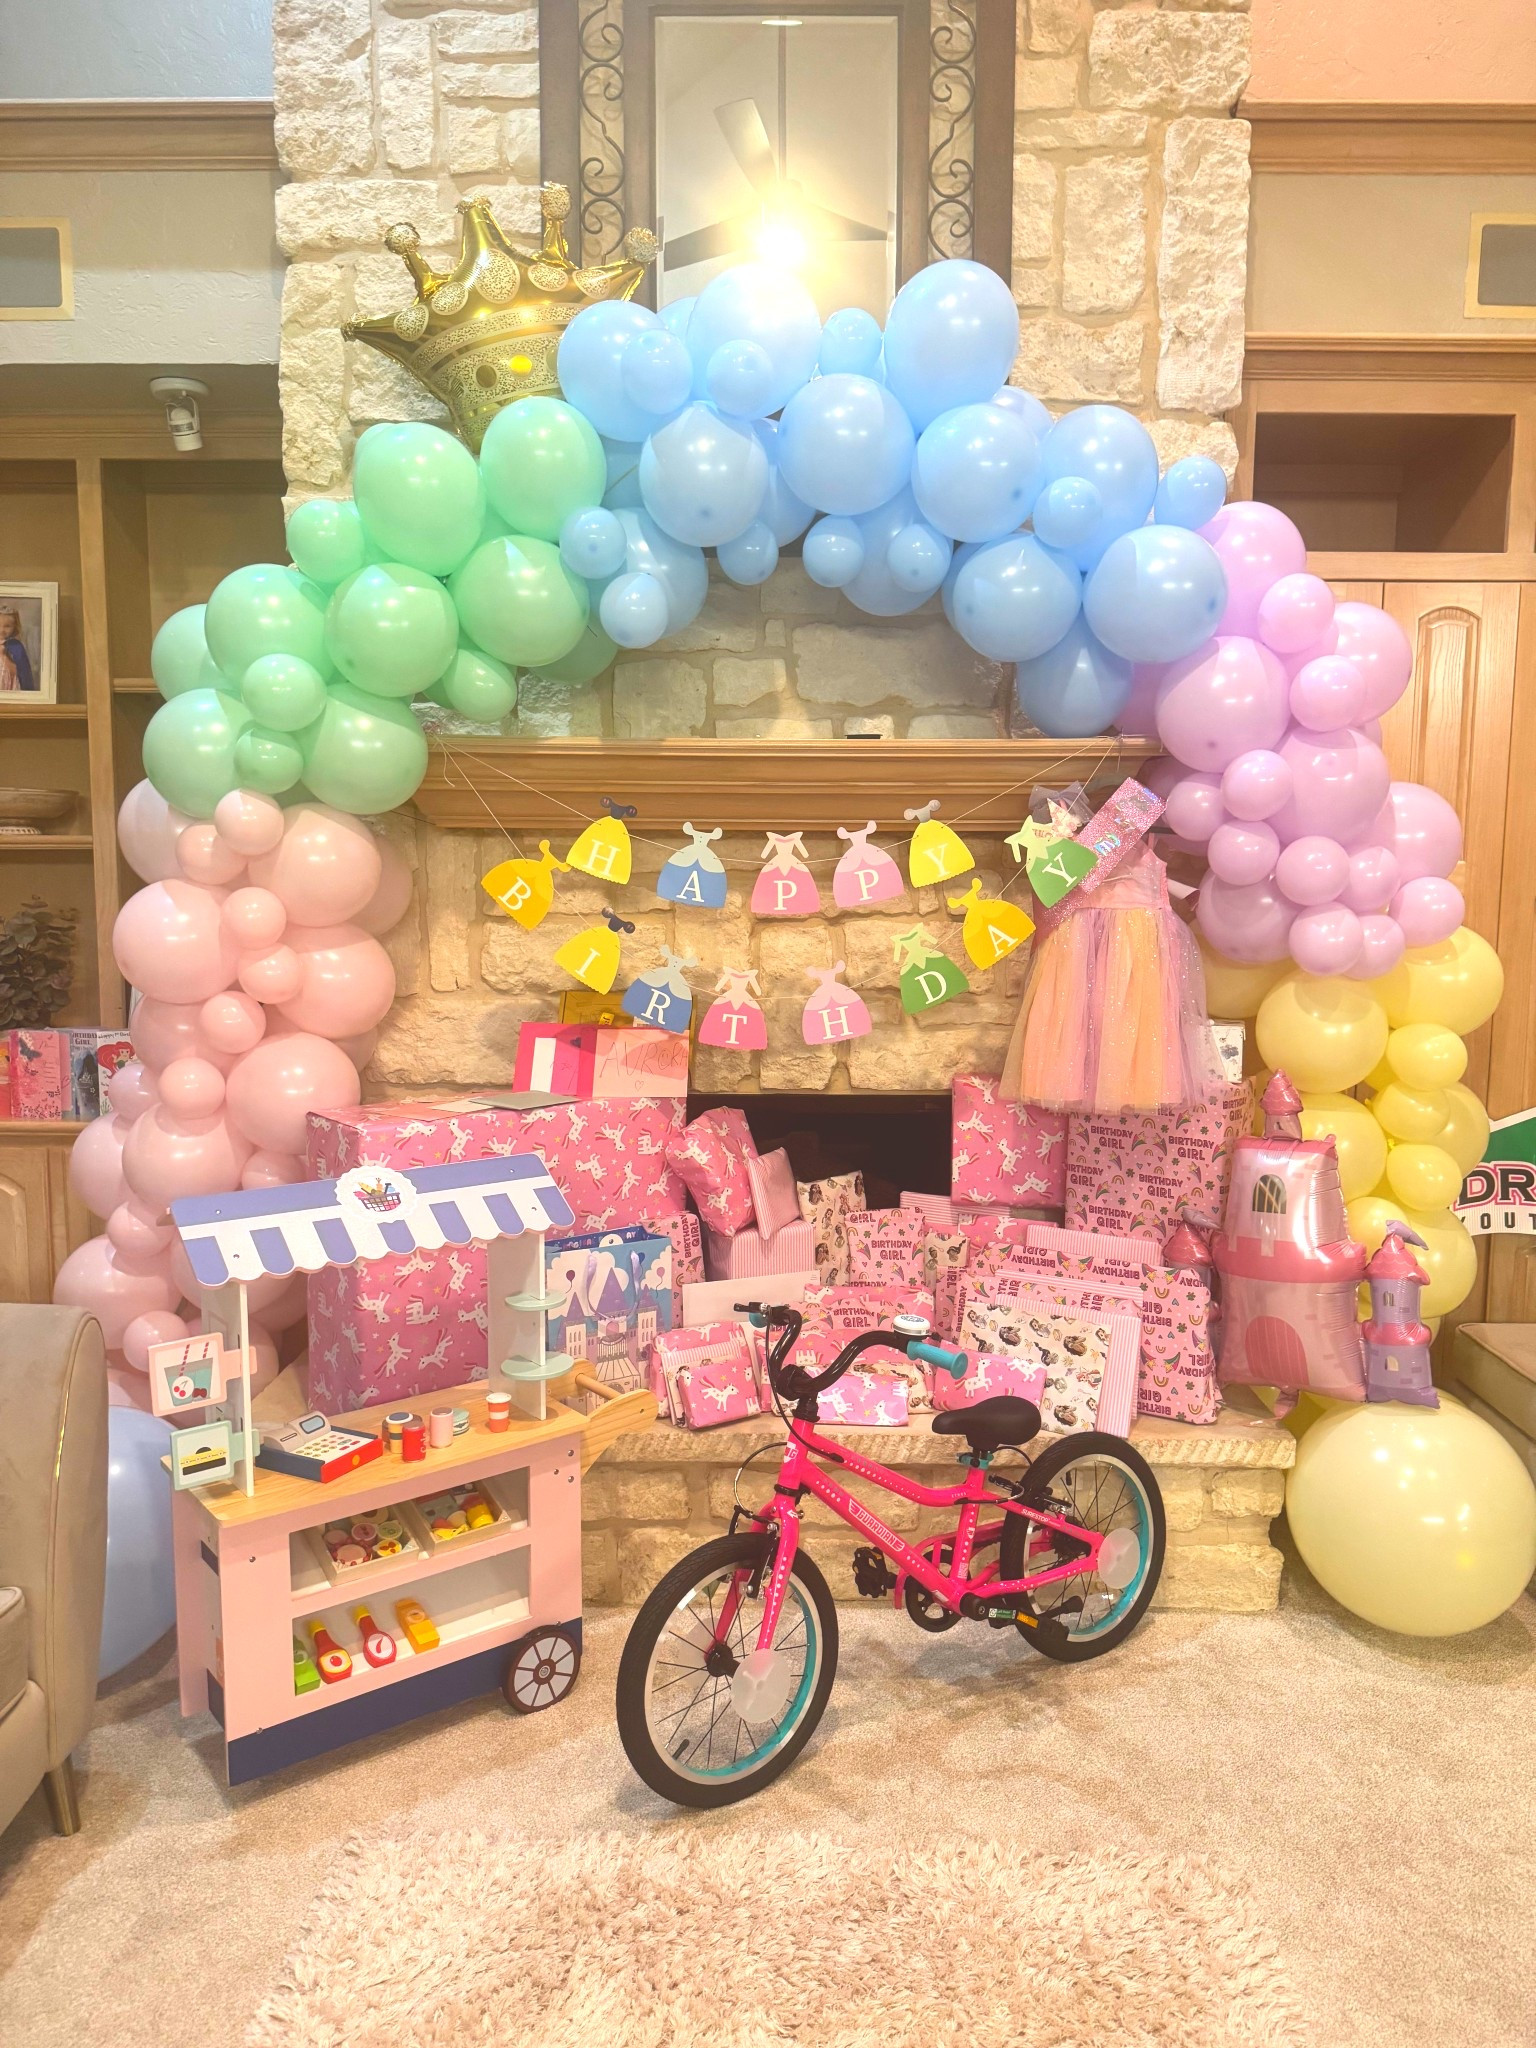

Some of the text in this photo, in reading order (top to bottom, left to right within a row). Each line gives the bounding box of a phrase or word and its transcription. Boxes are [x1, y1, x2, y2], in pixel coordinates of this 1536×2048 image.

[585, 841, 951, 913] HAPPY
[498, 851, 1077, 1046] BIRTHDAY
[1090, 1125, 1133, 1139] BIRTHDAY
[1098, 1137, 1125, 1150] GIRL
[1168, 1136, 1214, 1149] BIRTHDAY
[1177, 1147, 1206, 1161] GIRL
[1067, 1164, 1104, 1177] IRTHDAY
[1070, 1174, 1095, 1188] GIRL
[1138, 1174, 1183, 1188] BIRTHDAY
[1147, 1185, 1174, 1199] GIRL
[850, 1213, 876, 1223] GIRL
[1088, 1205, 1132, 1219] BIRTHDAY
[1097, 1217, 1123, 1230] GIRL
[1461, 1211, 1536, 1231] OUT
[680, 1214, 692, 1258] BIRTHDAY
[690, 1219, 700, 1247] GIRL
[871, 1240, 912, 1249] BIRTHDAY
[880, 1250, 906, 1260] GIRL
[1142, 1301, 1162, 1315] GIR
[843, 1317, 871, 1328] GIRL
[1142, 1314, 1172, 1327] BIRTH
[1138, 1387, 1161, 1403] GIR
[1137, 1401, 1171, 1415] BIRTHD
[1021, 1508, 1050, 1522] SURESTOP
[855, 1506, 899, 1548] GUARDIAN
